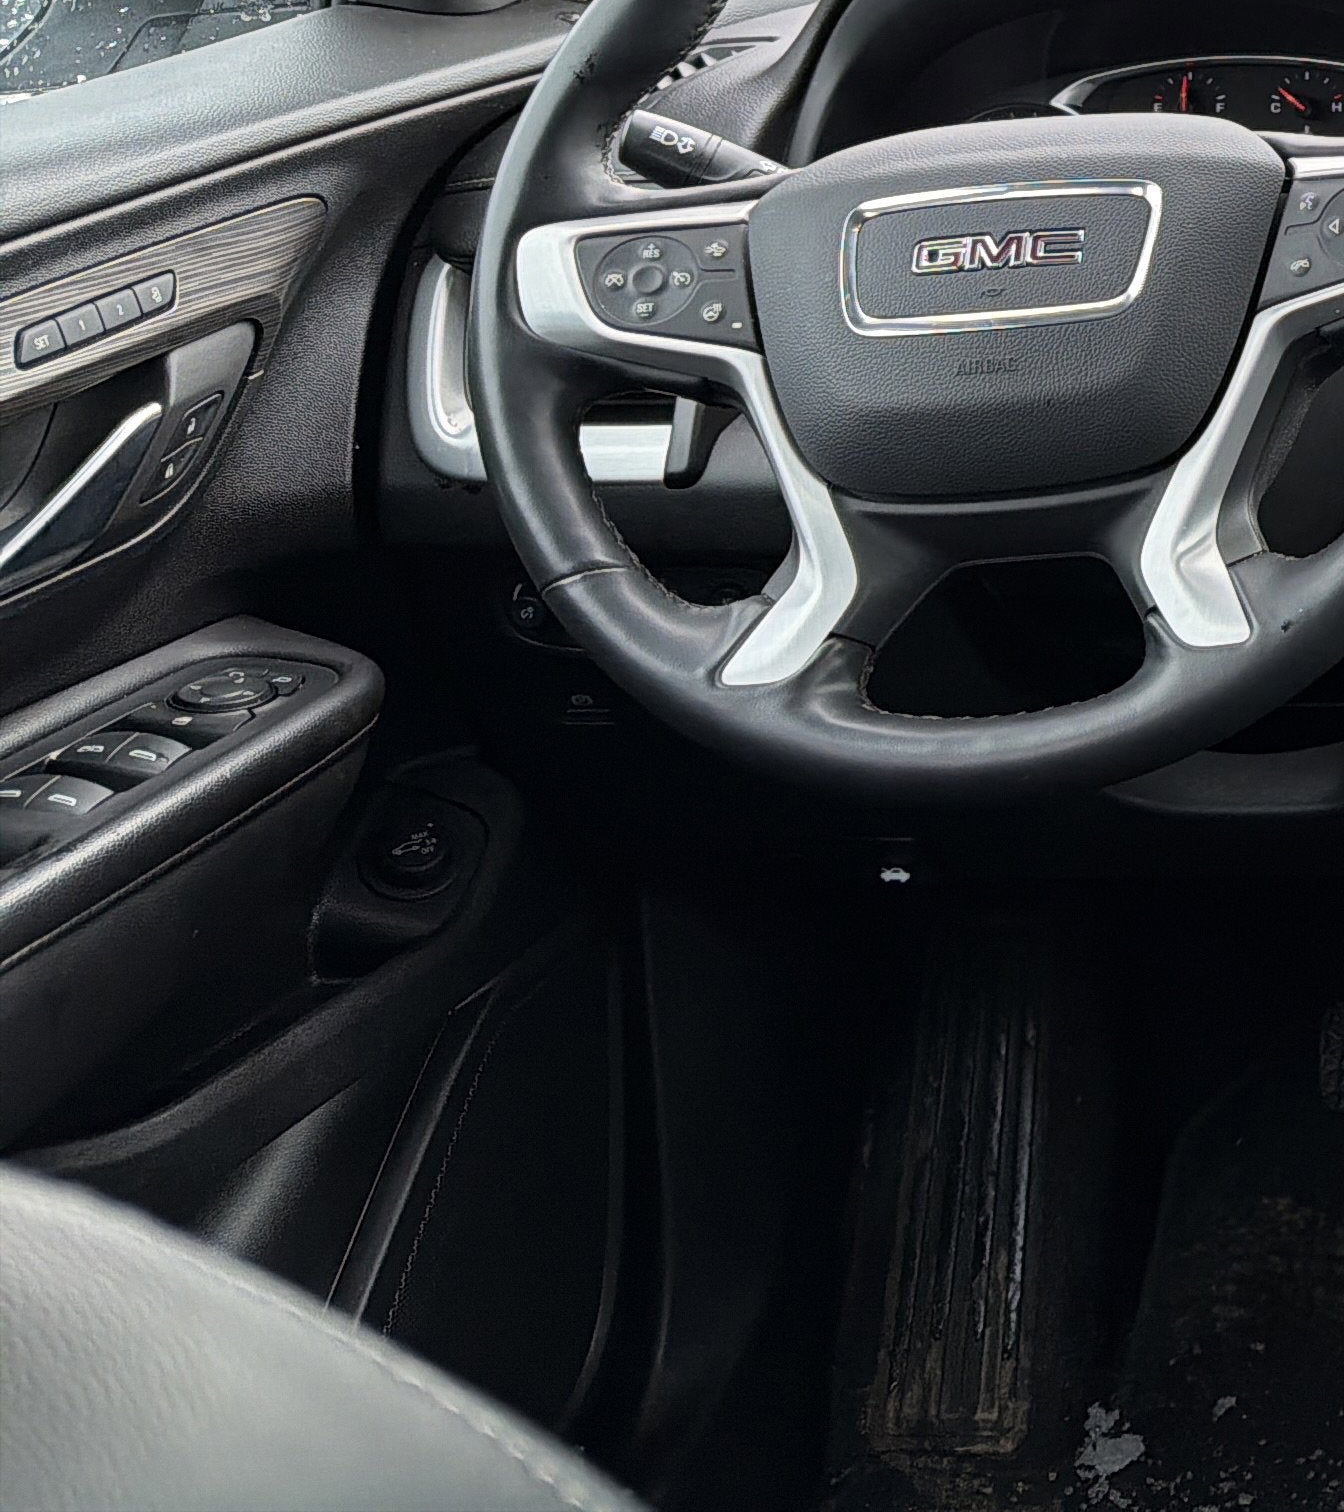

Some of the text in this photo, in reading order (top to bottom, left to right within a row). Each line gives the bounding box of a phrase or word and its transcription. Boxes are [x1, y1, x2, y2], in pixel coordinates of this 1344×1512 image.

[1154, 103, 1162, 112] E
[1216, 103, 1226, 113] F
[1270, 102, 1281, 113] C
[1331, 102, 1343, 113] H
[642, 249, 660, 259] RES
[911, 228, 1086, 276] GMC
[116, 303, 124, 316] 2
[636, 302, 654, 313] SET
[78, 319, 86, 331] 1
[33, 334, 50, 351] SET
